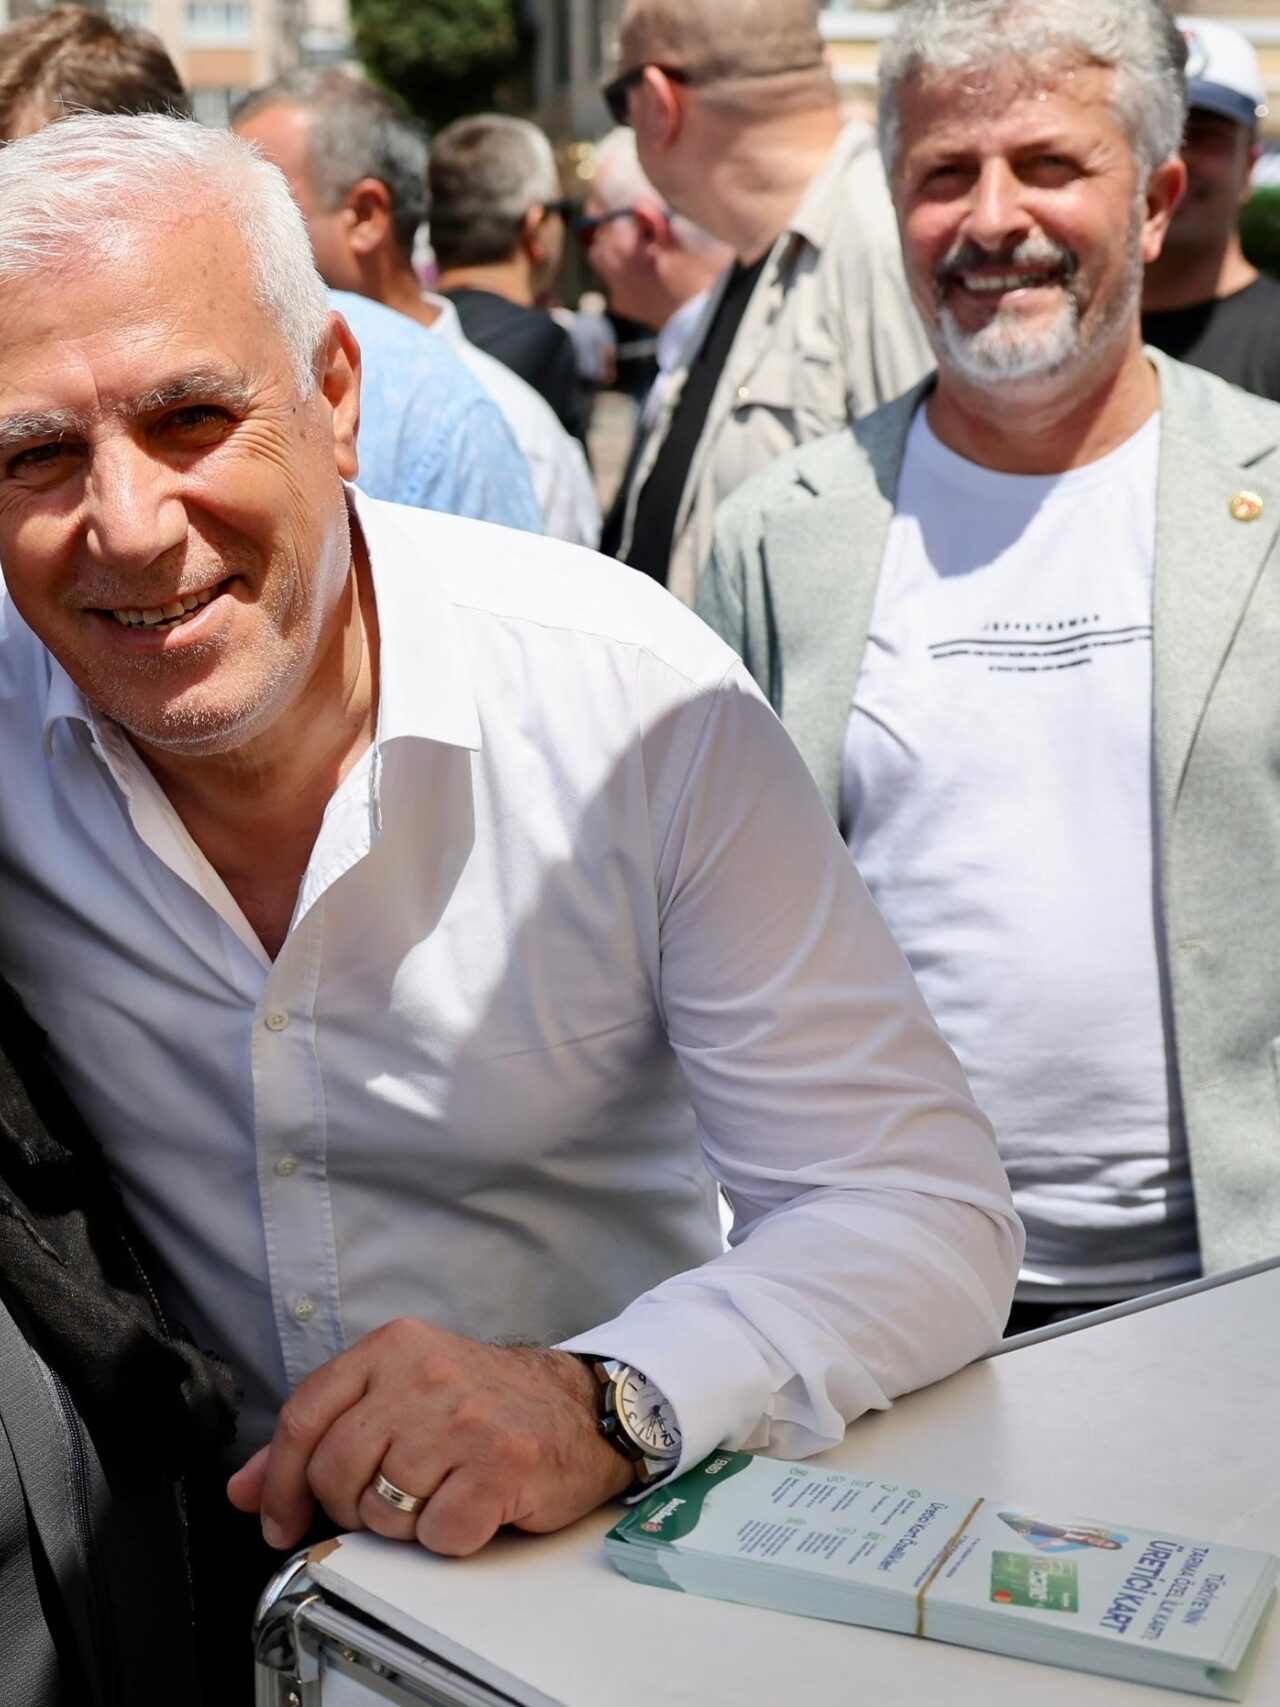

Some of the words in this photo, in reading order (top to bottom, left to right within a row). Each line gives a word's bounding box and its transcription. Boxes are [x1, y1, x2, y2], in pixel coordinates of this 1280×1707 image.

[1122, 1540, 1185, 1596] ÜRETİCİ
[1165, 1577, 1195, 1598] ÖZEL
[1099, 1592, 1145, 1634] KART
